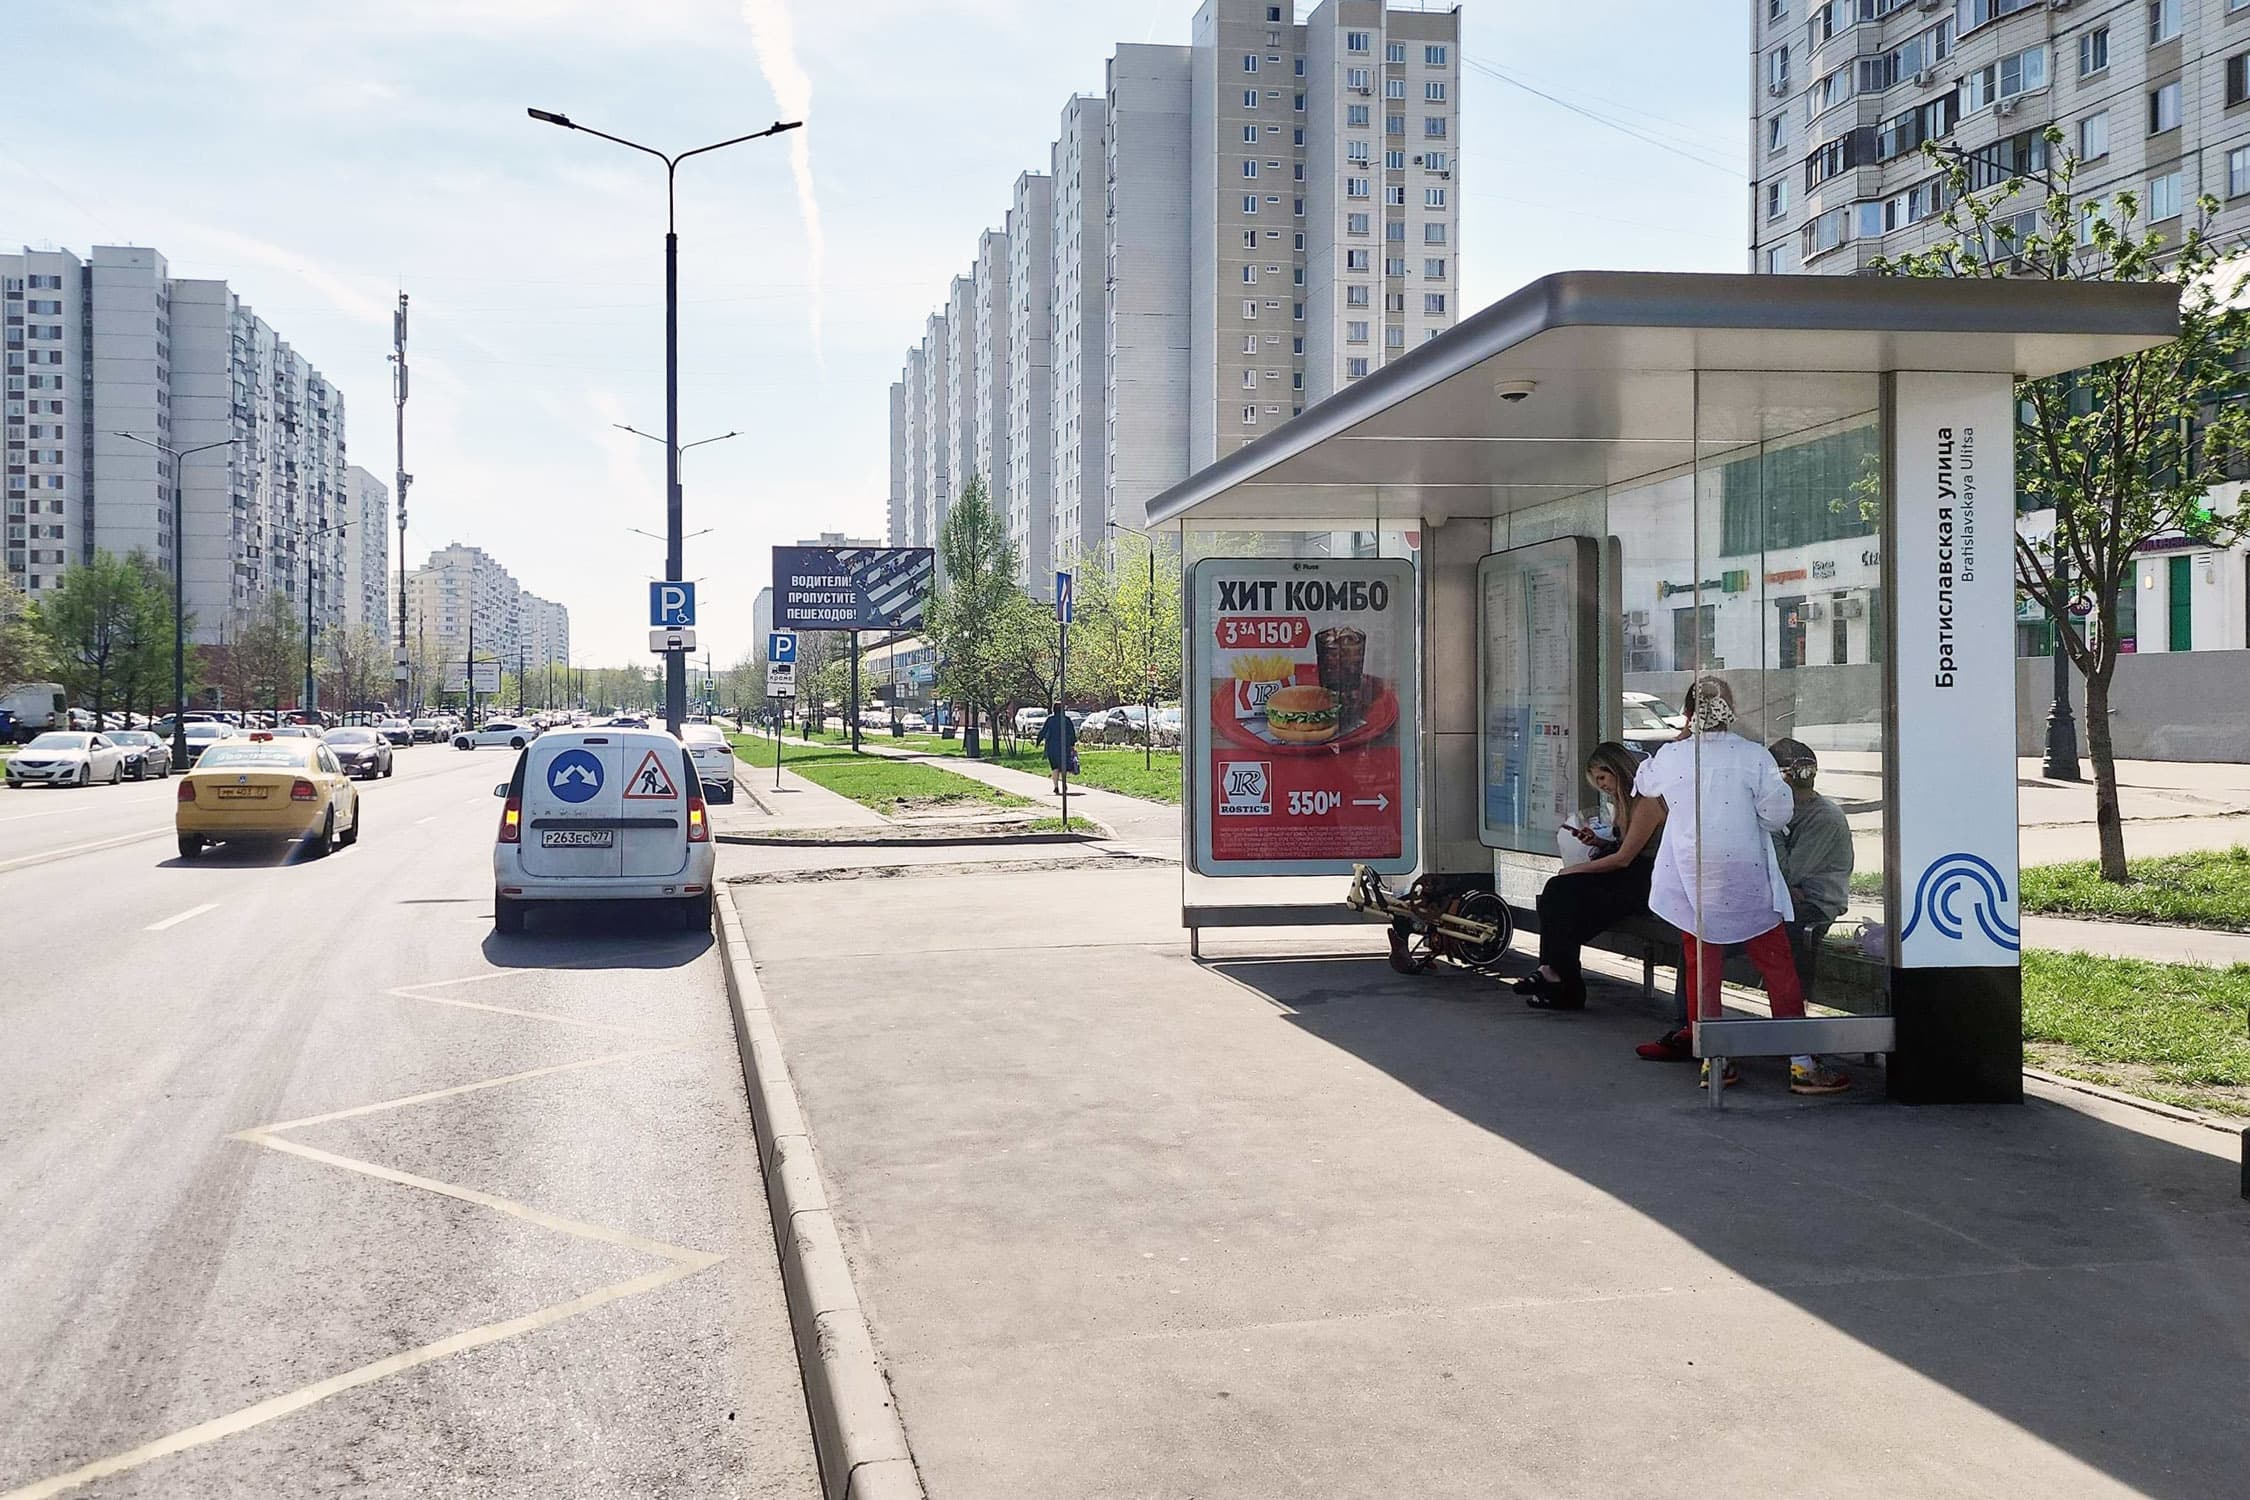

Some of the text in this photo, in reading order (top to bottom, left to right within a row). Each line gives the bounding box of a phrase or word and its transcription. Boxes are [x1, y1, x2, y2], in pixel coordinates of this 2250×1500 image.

[1961, 427, 1977, 583] Bratislavskaya Ulitsa
[1935, 427, 1959, 689] Братиславская улица
[791, 575, 852, 588] ВОДИТЕЛИ!
[661, 587, 685, 621] P
[788, 591, 857, 605] ПРОПУСТИТЕ
[1217, 580, 1388, 611] ХИТ КОМБО
[786, 608, 857, 621] ПЕШЕХОДОВ!
[1225, 622, 1237, 644] 3
[1240, 623, 1255, 635] ЗА
[775, 637, 793, 660] P
[1221, 805, 1270, 814] ROSTIC'S
